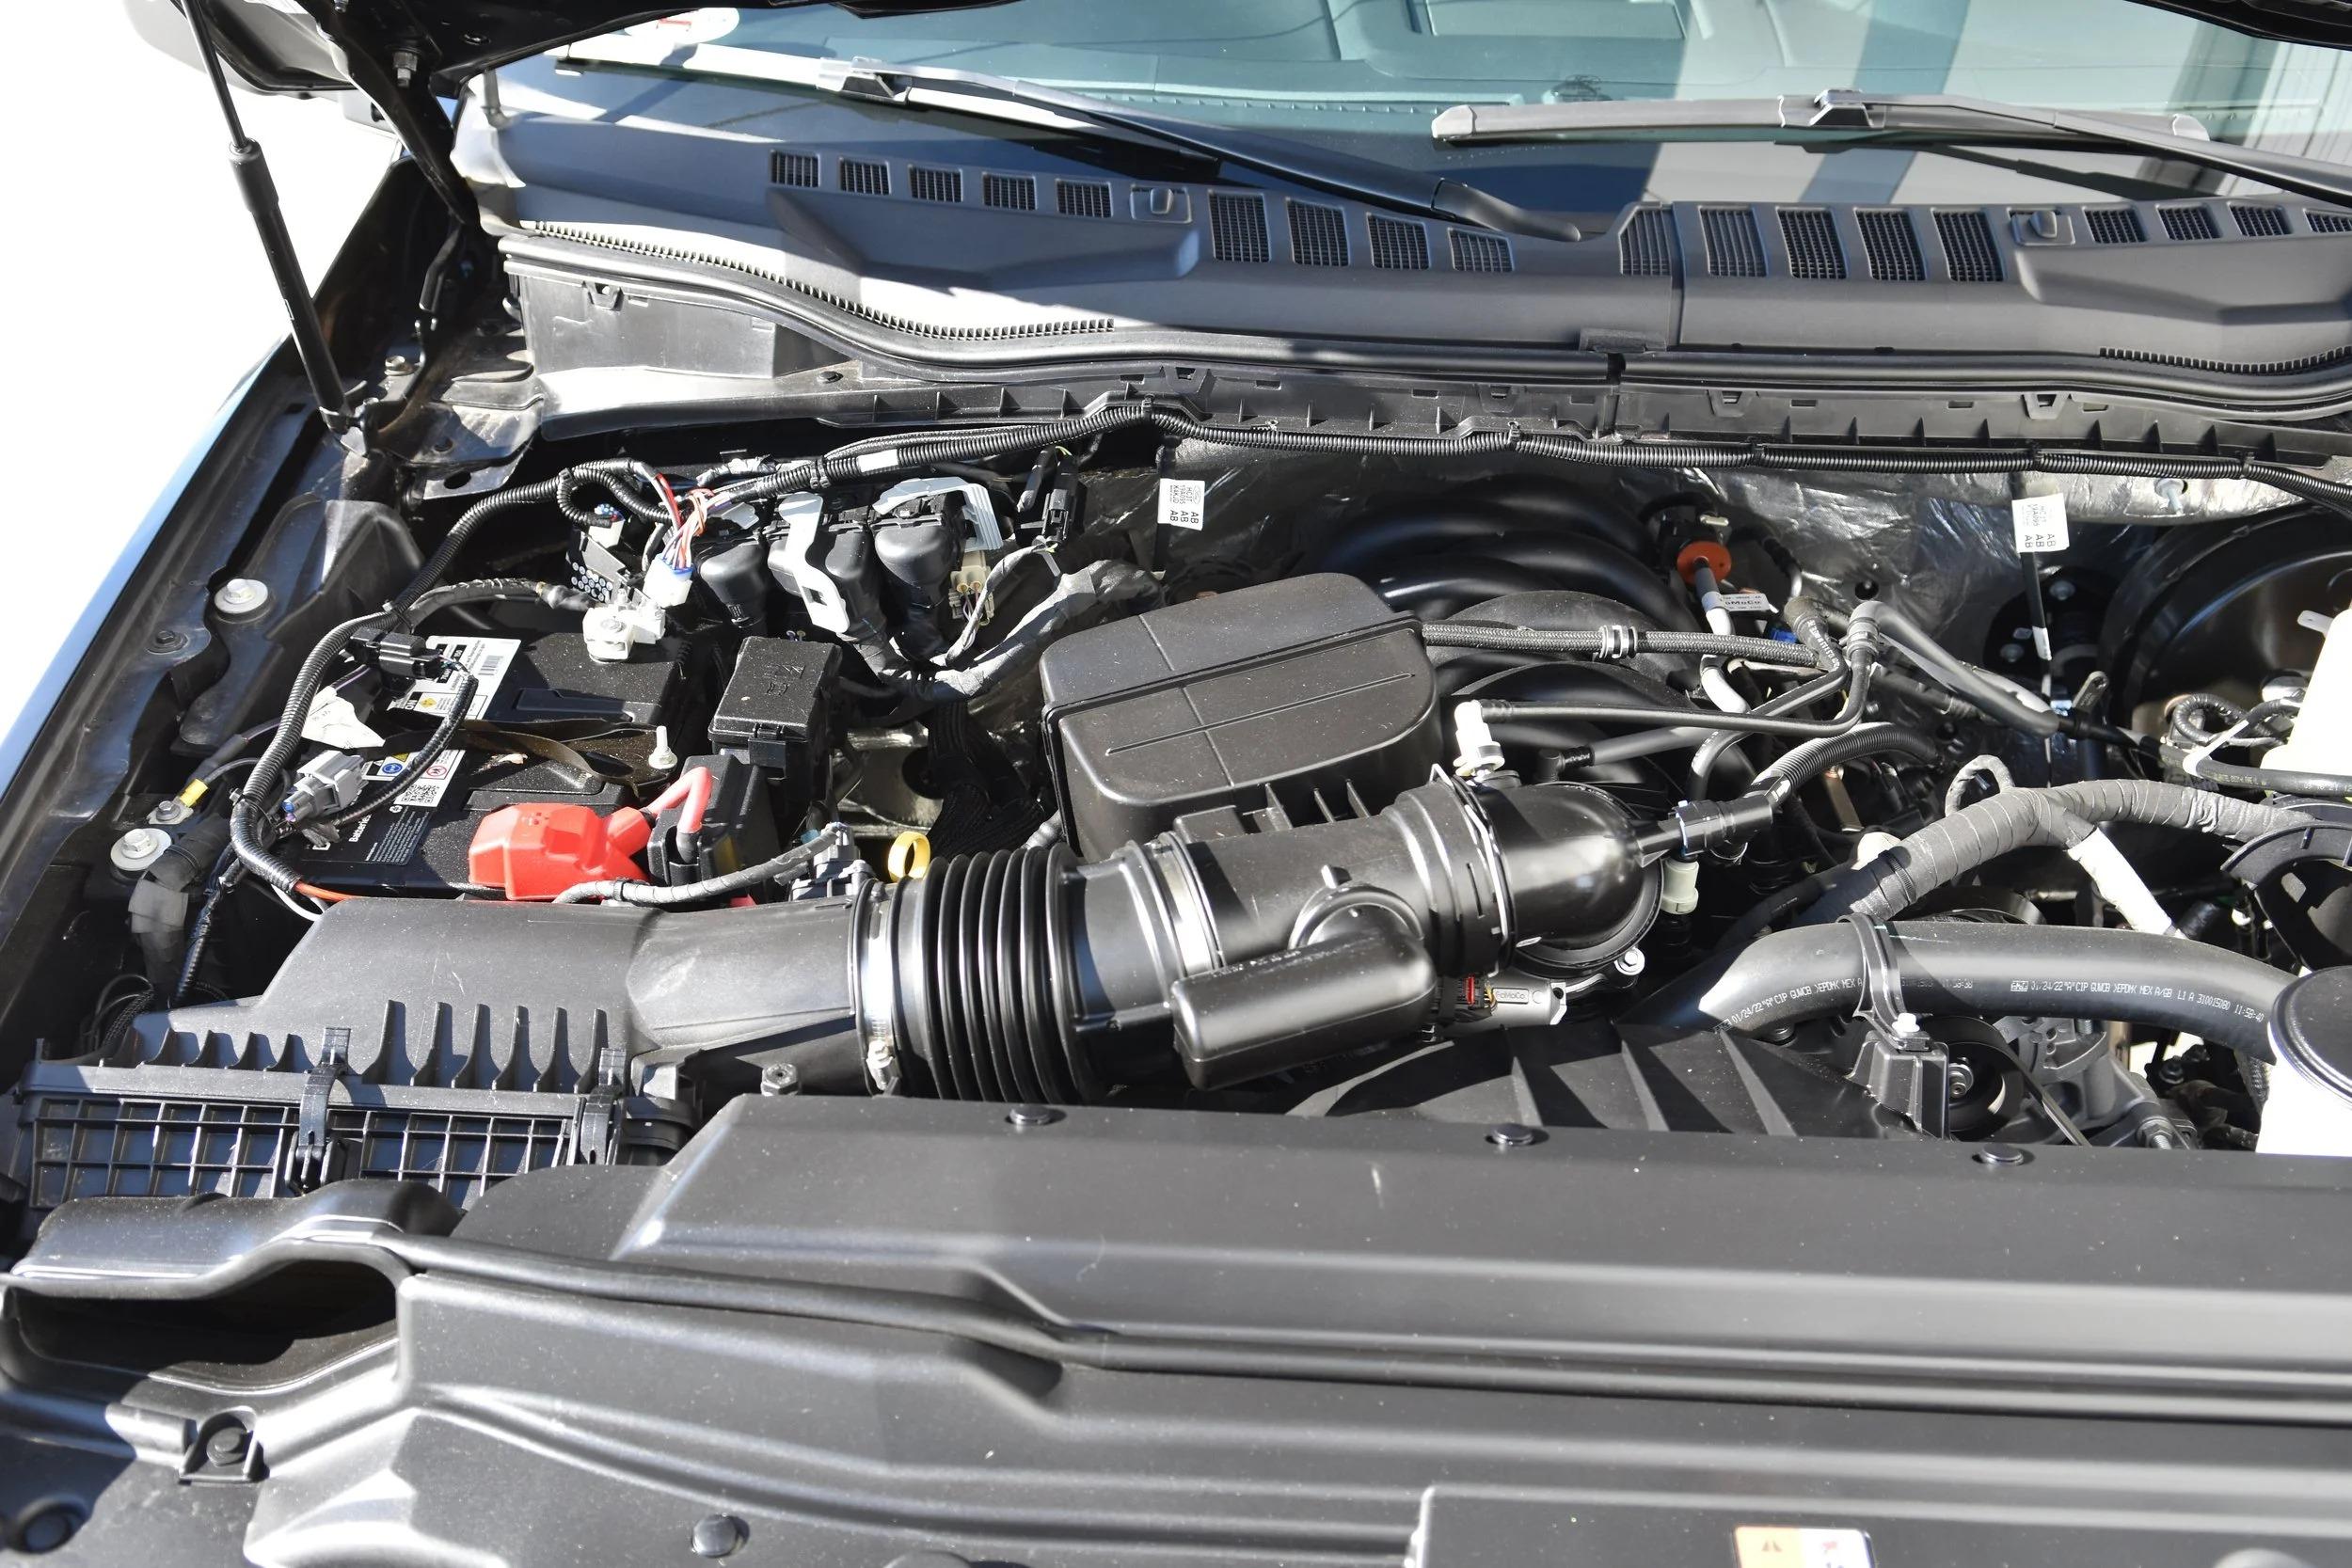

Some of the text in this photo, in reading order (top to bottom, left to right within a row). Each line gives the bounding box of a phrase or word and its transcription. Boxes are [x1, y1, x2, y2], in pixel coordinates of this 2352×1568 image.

[1170, 510, 1179, 522] AB
[1181, 511, 1189, 523] AB
[1191, 512, 1200, 524] AB
[2025, 534, 2034, 548] AB
[2035, 533, 2045, 547] AB
[2047, 533, 2057, 547] AB
[1774, 992, 1788, 1005] CIP
[1842, 979, 1855, 989] MEX
[2075, 981, 2089, 992] CIP
[2139, 986, 2153, 995] MEX
[2188, 991, 2195, 1002] A
